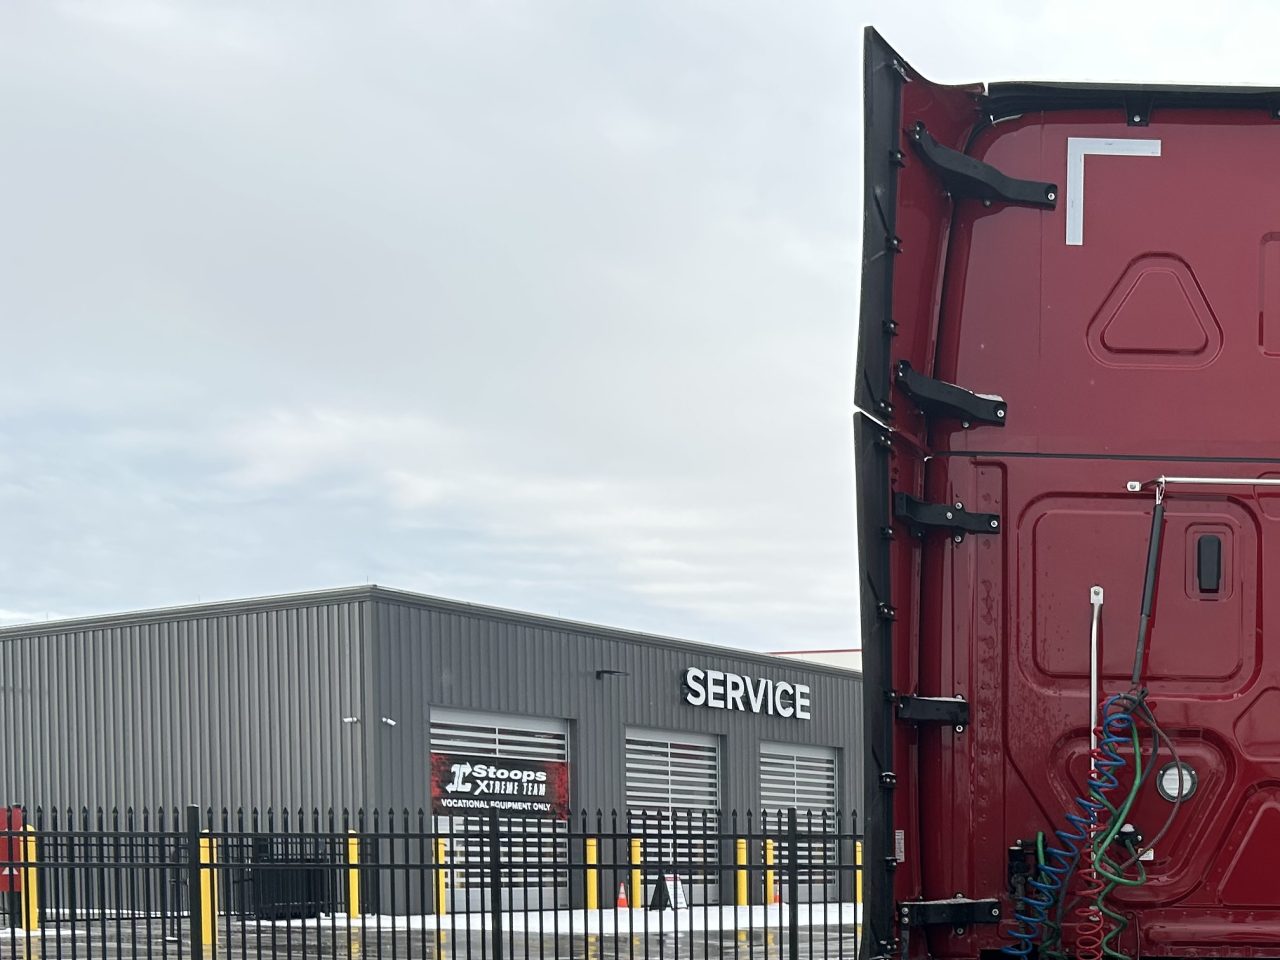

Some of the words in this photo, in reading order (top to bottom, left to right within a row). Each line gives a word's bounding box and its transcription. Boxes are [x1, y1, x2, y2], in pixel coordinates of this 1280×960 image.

[686, 666, 811, 720] SERVICE
[472, 764, 547, 782] Stoops
[474, 780, 518, 796] XTREME
[523, 783, 546, 796] TEAM
[441, 799, 489, 809] VOCATIONAL
[534, 803, 551, 811] ONLY
